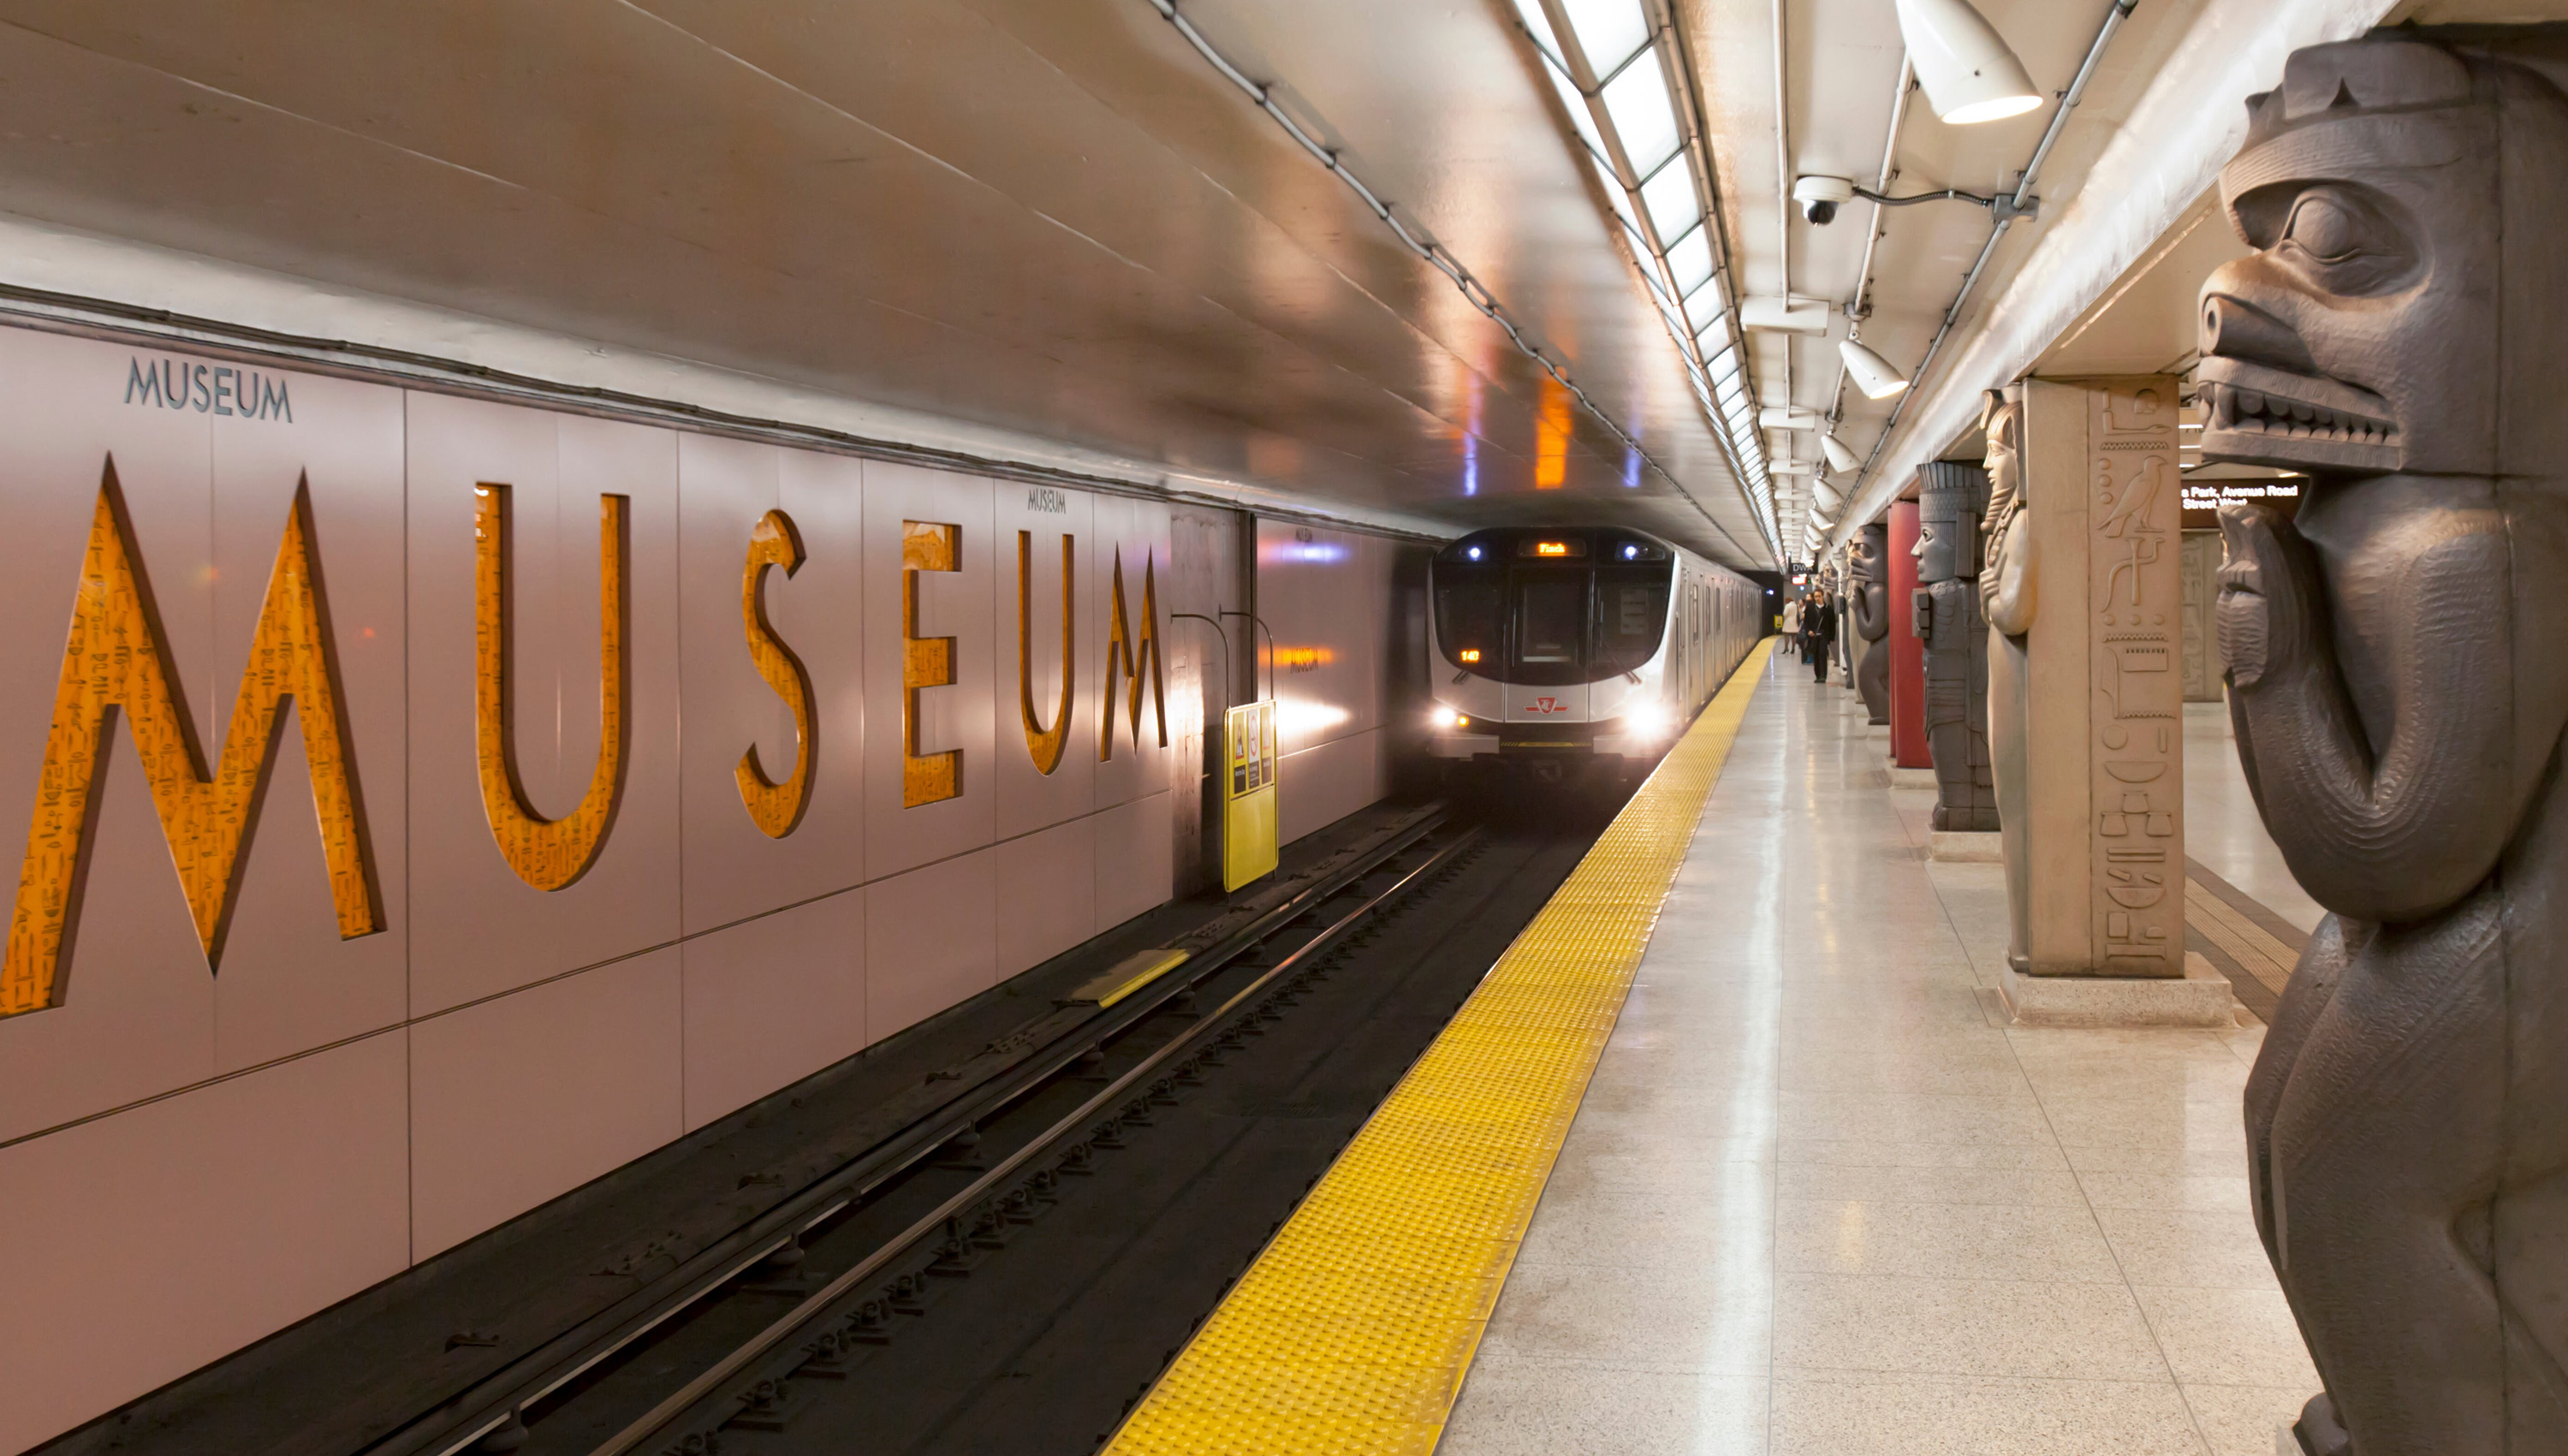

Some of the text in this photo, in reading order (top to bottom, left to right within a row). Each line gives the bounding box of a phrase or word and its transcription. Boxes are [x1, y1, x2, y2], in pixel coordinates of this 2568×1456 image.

[124, 355, 293, 424] MUSEUM
[1027, 488, 1067, 514] MUSEUM
[2191, 486, 2220, 498] Park,
[2221, 485, 2266, 496] Avenue
[2266, 484, 2298, 496] Road
[2182, 498, 2217, 509] Street
[1538, 543, 1566, 554] Finch
[0, 450, 1168, 1019] MUSEUM
